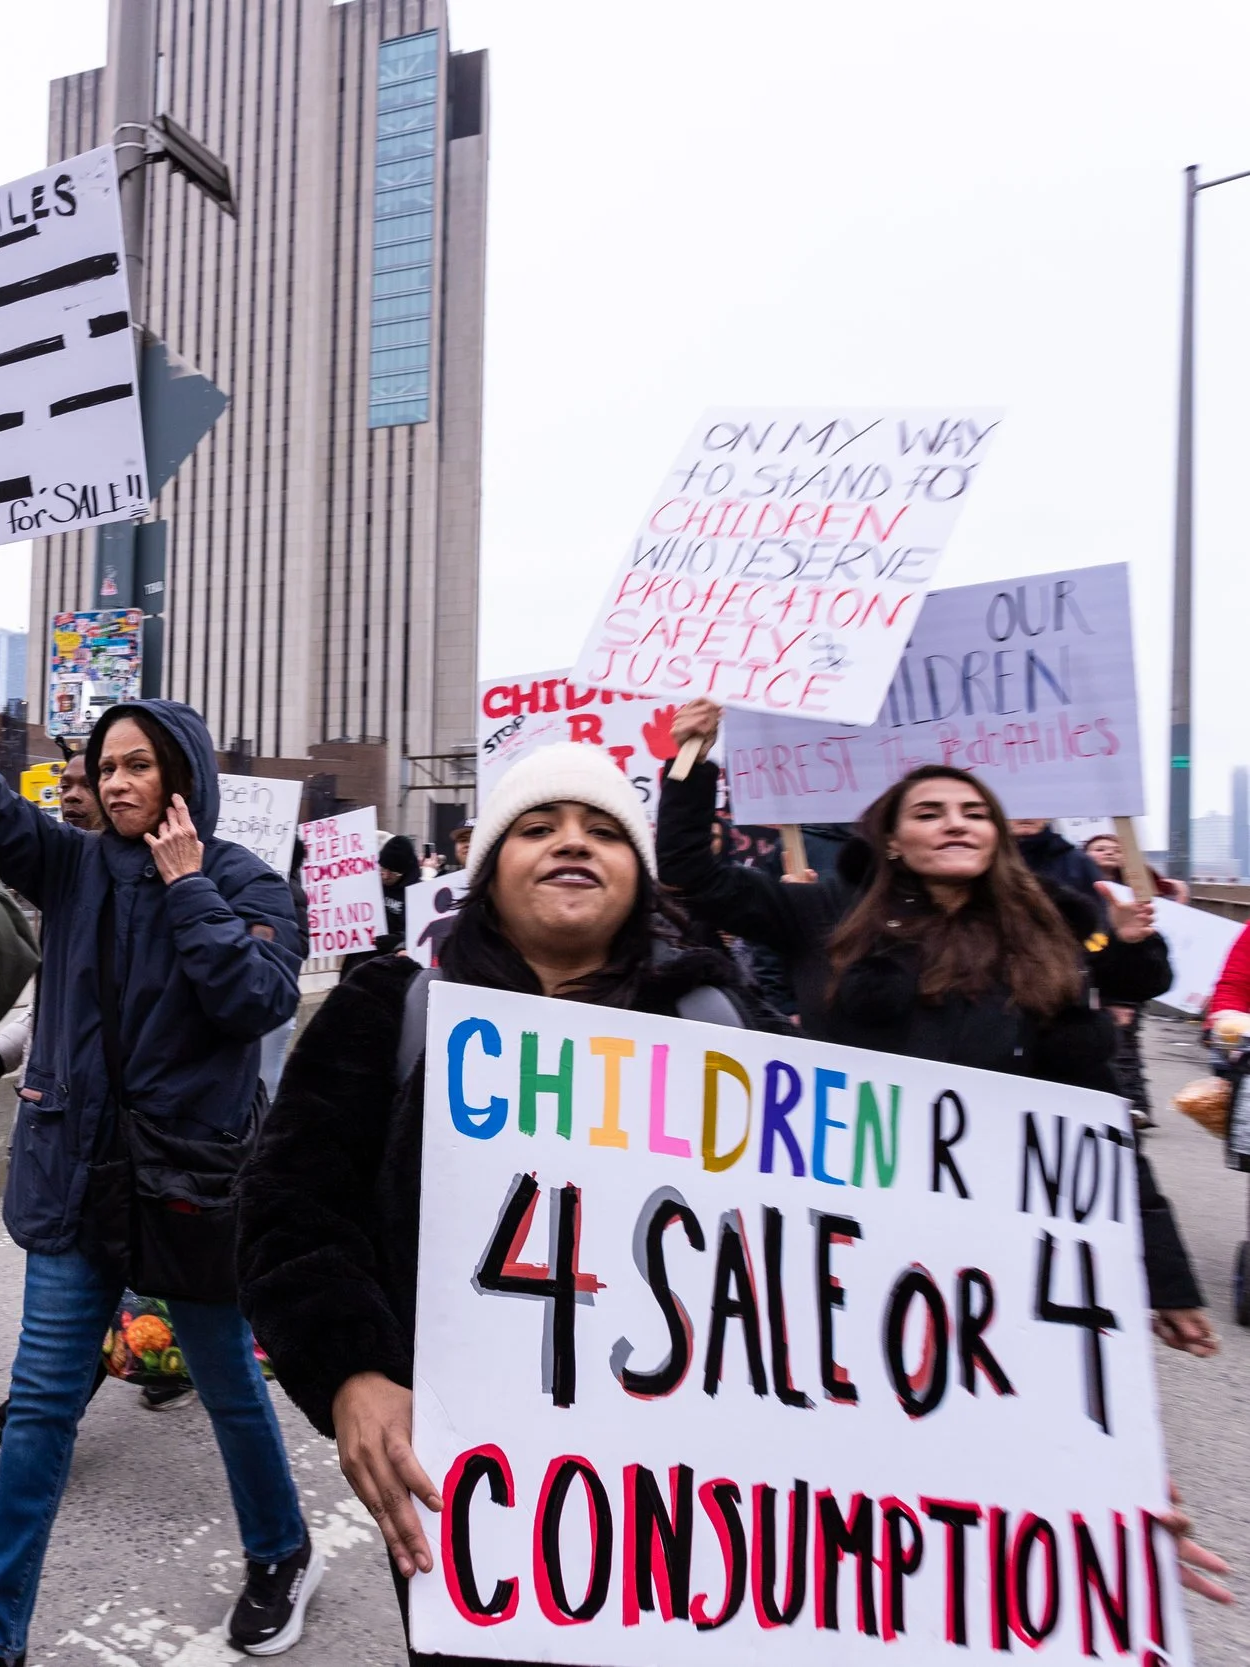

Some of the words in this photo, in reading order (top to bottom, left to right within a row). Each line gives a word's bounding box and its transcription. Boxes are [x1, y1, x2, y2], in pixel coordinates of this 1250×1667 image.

[703, 420, 778, 456] ON
[778, 417, 885, 457] MY
[897, 417, 1002, 459] WAY
[7, 499, 50, 534] for
[649, 497, 911, 543] CHILDREN
[986, 579, 1097, 643] OUR
[588, 645, 845, 711] JUSTICE
[482, 714, 526, 754] STOP
[565, 713, 604, 746] R
[732, 734, 861, 803] ARREST
[302, 818, 339, 842] FOR
[303, 832, 365, 862] THEIR
[305, 883, 332, 906] WE
[307, 902, 375, 930] STAND
[310, 925, 377, 953] TODAY
[447, 1016, 902, 1190] CHILDREN
[930, 1088, 971, 1200] R
[1019, 1111, 1135, 1225] NOT
[470, 1170, 608, 1408] 4
[609, 1184, 864, 1411] SALE
[881, 1260, 1017, 1420] OR
[1031, 1229, 1120, 1436] 4
[440, 1442, 1170, 1667] CONSUMPTION!
